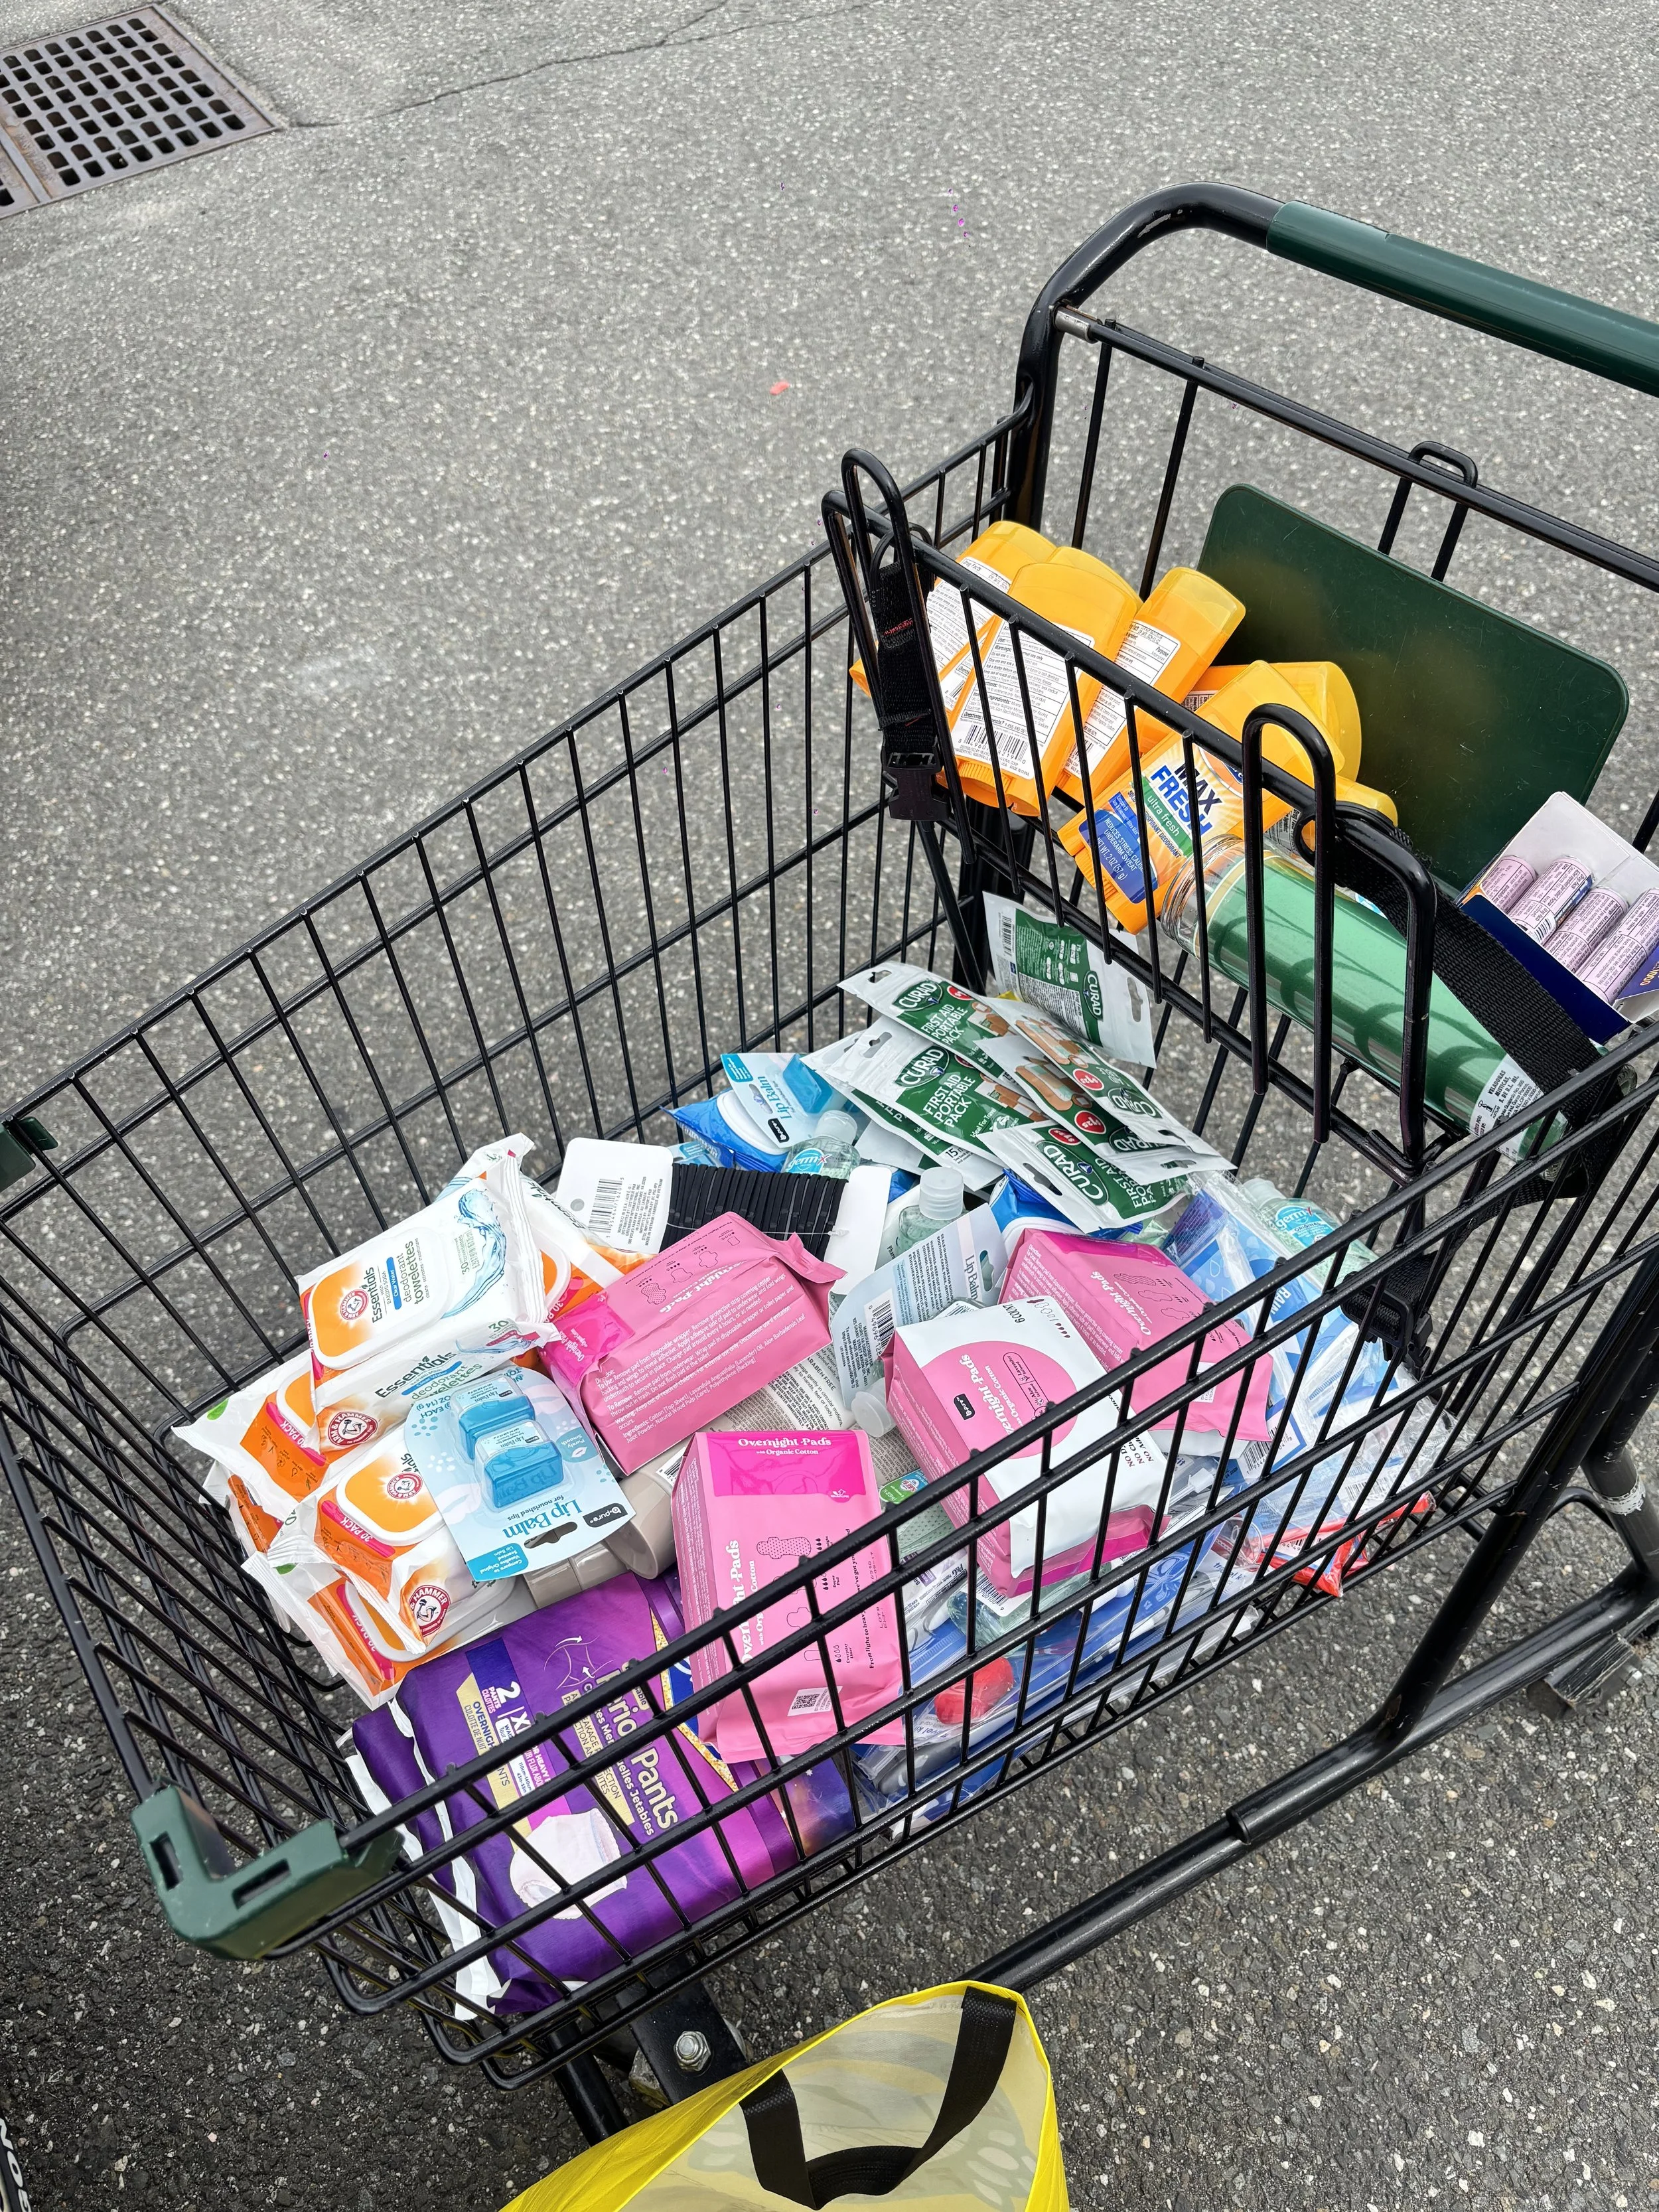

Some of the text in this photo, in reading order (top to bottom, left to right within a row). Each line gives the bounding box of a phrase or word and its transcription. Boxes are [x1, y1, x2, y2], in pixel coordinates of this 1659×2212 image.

[1173, 760, 1222, 815] MAX
[1146, 794, 1182, 836] ultra fresh
[1149, 766, 1212, 839] FRESH
[1099, 845, 1110, 857] WT.
[1104, 818, 1132, 855] REDUCES STRESS
[1104, 829, 1136, 871] UNDERARM SWEAT
[1158, 832, 1181, 859] DEODORANT
[1108, 857, 1118, 867] OZ
[1112, 863, 1123, 875] (57
[1117, 871, 1128, 881] g)
[897, 978, 939, 1013] CURAD
[1082, 972, 1107, 1017] CURAD
[920, 1003, 954, 1033] FIRST AID
[931, 1006, 968, 1039] PORTABLE
[942, 1026, 964, 1046] PACK
[901, 1047, 944, 1085] CURAD
[922, 1072, 961, 1114] FIRST AID
[1487, 1069, 1506, 1094] VELADORAS
[758, 1076, 792, 1118] Lip Balm
[933, 1076, 975, 1122] PORTABLE
[944, 1097, 972, 1128] PACK
[970, 1126, 982, 1138] Ideal
[984, 1107, 997, 1119] Travel
[1043, 1143, 1104, 1200] CURAD
[1094, 1157, 1143, 1209] FIRST AID
[396, 1252, 412, 1302] deodorant
[403, 1240, 424, 1304] towelettes
[461, 1262, 470, 1274] 30
[962, 1254, 981, 1299] Lip Balm
[362, 1267, 382, 1323] Essentials
[657, 1290, 695, 1314] Pads
[1090, 1271, 1151, 1333] Overnight Pads
[1003, 1303, 1023, 1317] COUNT
[869, 1317, 879, 1340] 49696
[375, 1349, 457, 1399] Essentials
[411, 1361, 468, 1402] deodorant
[823, 1376, 835, 1390] FREE
[960, 1355, 983, 1383] Pads
[1006, 1355, 1036, 1398] Aloe Lavender
[802, 1376, 814, 1392] hands,
[813, 1390, 822, 1400] feet
[806, 1374, 819, 1387] gently
[821, 1390, 834, 1407] circular
[984, 1366, 1019, 1416] Organic Cotton
[279, 1420, 300, 1440] PACK
[336, 1409, 371, 1428] HAMMER
[561, 1434, 582, 1445] Smooth
[567, 1438, 585, 1448] Purely
[738, 1438, 798, 1447] Overnight
[1125, 1455, 1135, 1467] NO
[1134, 1453, 1144, 1463] NO
[1144, 1451, 1153, 1461] NO
[502, 1497, 581, 1540] Lip Balm
[507, 1512, 520, 1521] lips
[520, 1499, 553, 1516] nourished
[339, 1515, 372, 1543] 30 PACK
[479, 1562, 499, 1574] Original
[500, 1559, 522, 1570] Compare
[725, 1539, 743, 1582] Pads
[747, 1560, 758, 1591] Cotton
[414, 1587, 447, 1604] HAMMER
[481, 1688, 496, 1714] CULOTTES
[488, 1686, 502, 1709] PANTS
[495, 1679, 523, 1704] 2
[464, 1704, 486, 1750] CULOTTE DE NUIT
[527, 1757, 539, 1773] FLUX
[535, 1753, 549, 1778] HEAVY
[630, 1745, 680, 1830] Pants
[628, 1787, 655, 1836] Jetables
